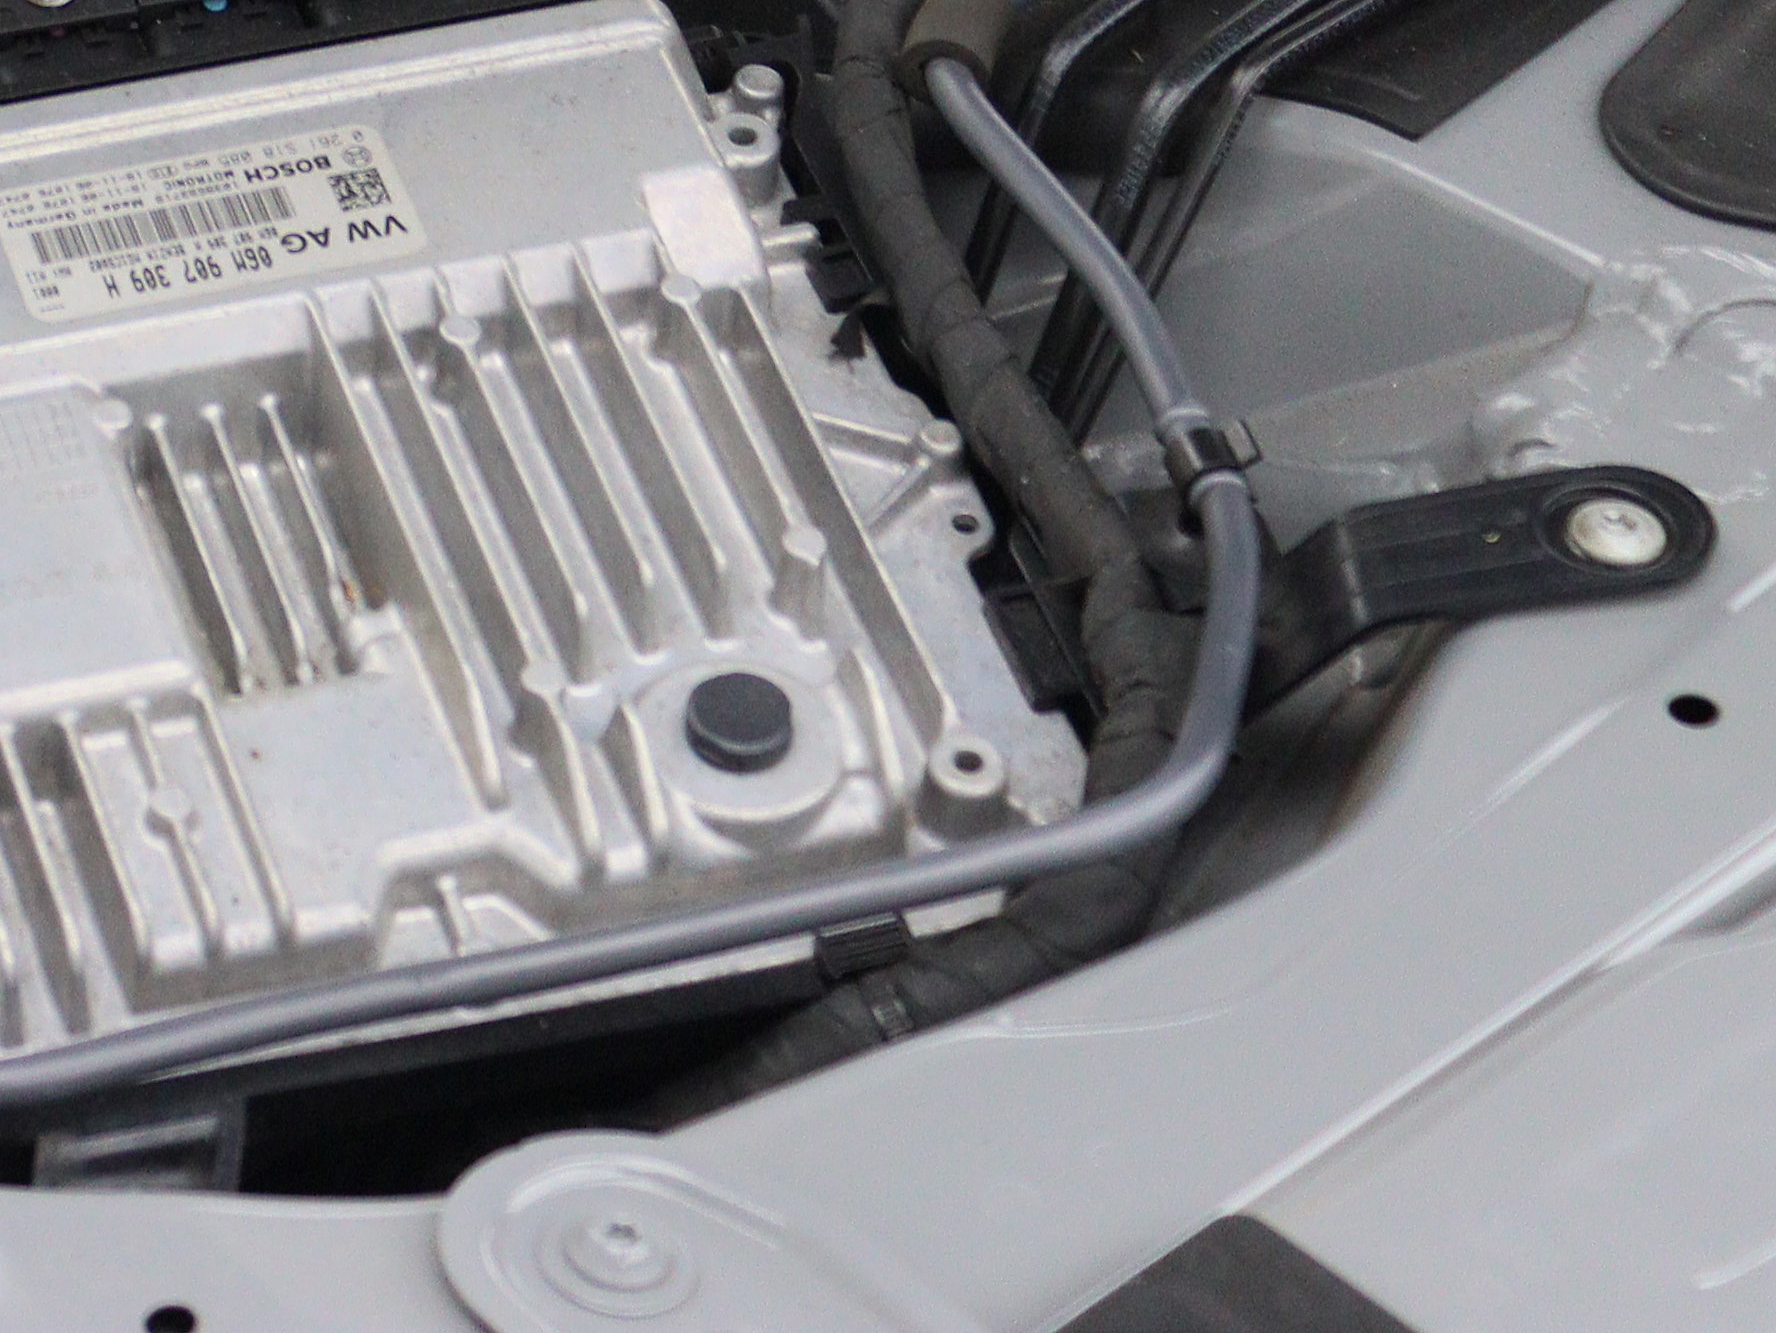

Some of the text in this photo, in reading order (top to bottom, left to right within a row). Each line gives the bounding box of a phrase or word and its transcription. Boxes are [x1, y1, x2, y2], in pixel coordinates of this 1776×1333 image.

[243, 155, 332, 183] BOSCH
[281, 215, 408, 253] VW AG
[183, 256, 222, 283] 907
[231, 246, 272, 272] 06M
[130, 265, 171, 293] 309
